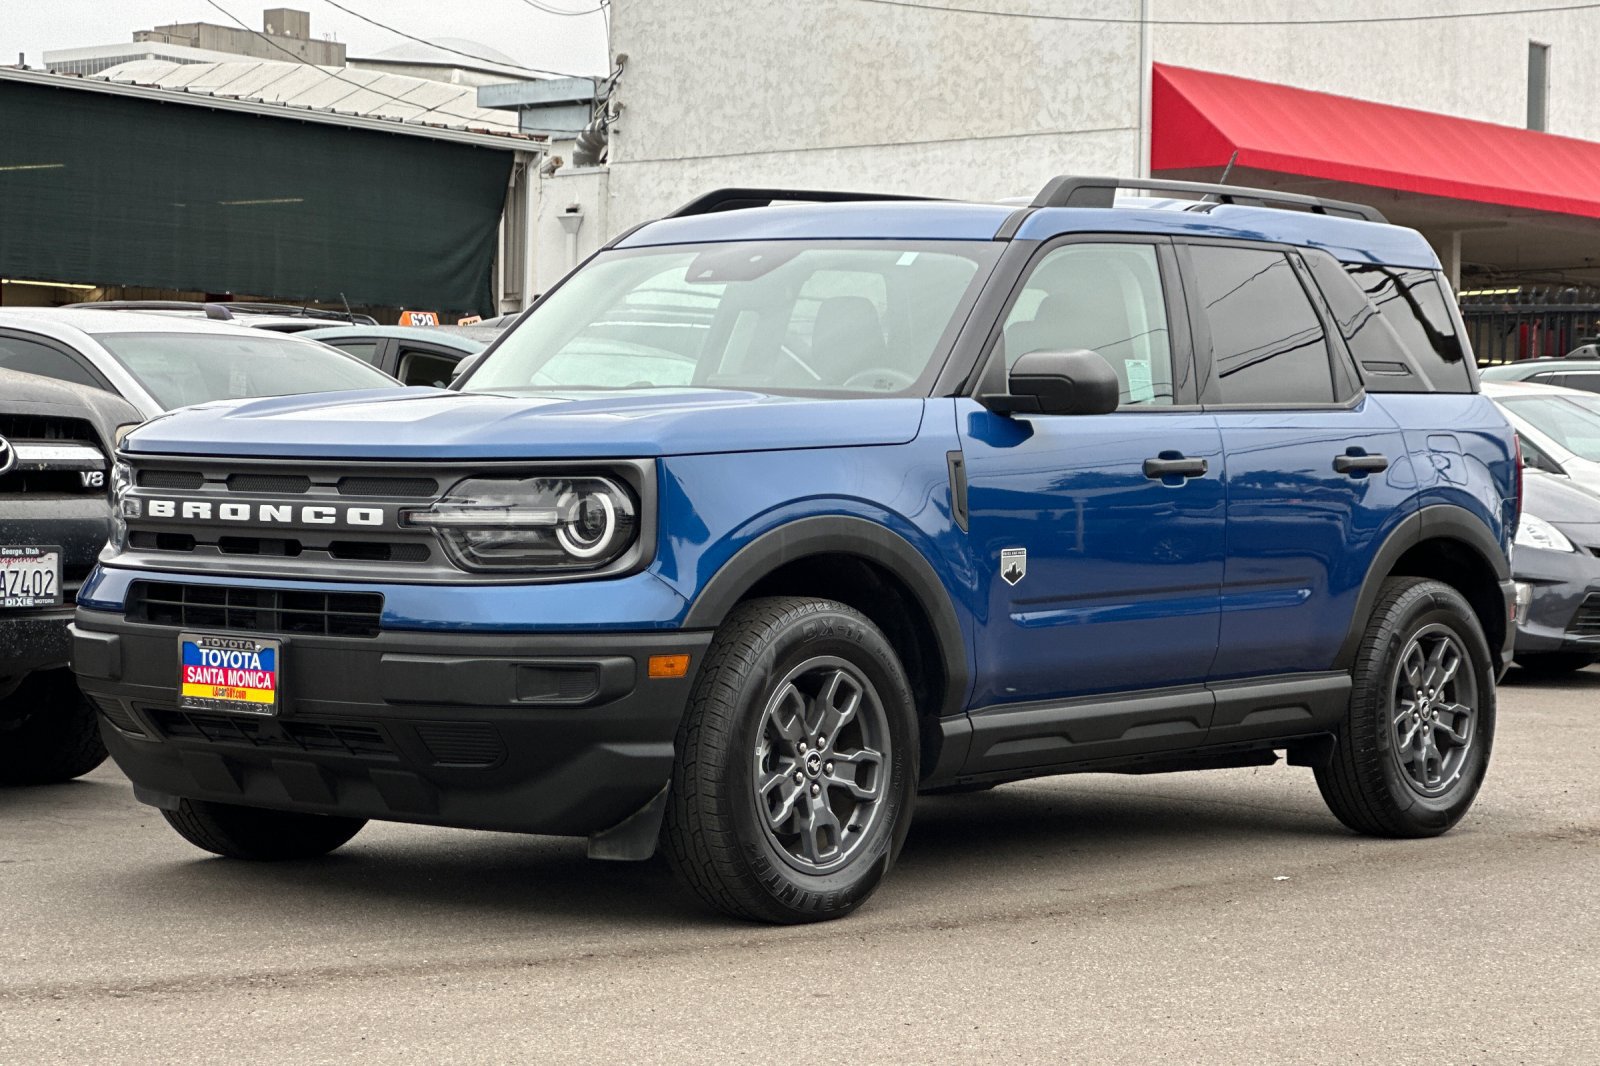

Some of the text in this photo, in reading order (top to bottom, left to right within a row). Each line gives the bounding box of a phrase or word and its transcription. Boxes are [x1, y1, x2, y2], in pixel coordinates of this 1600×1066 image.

[81, 471, 104, 487] V8
[148, 500, 384, 525] BRONCO
[25, 547, 40, 555] Utah
[6, 597, 33, 607] DIXIE
[204, 638, 254, 650] TOYOTA
[199, 649, 262, 670] TOYOTA
[187, 666, 272, 689] SANTA MONICA
